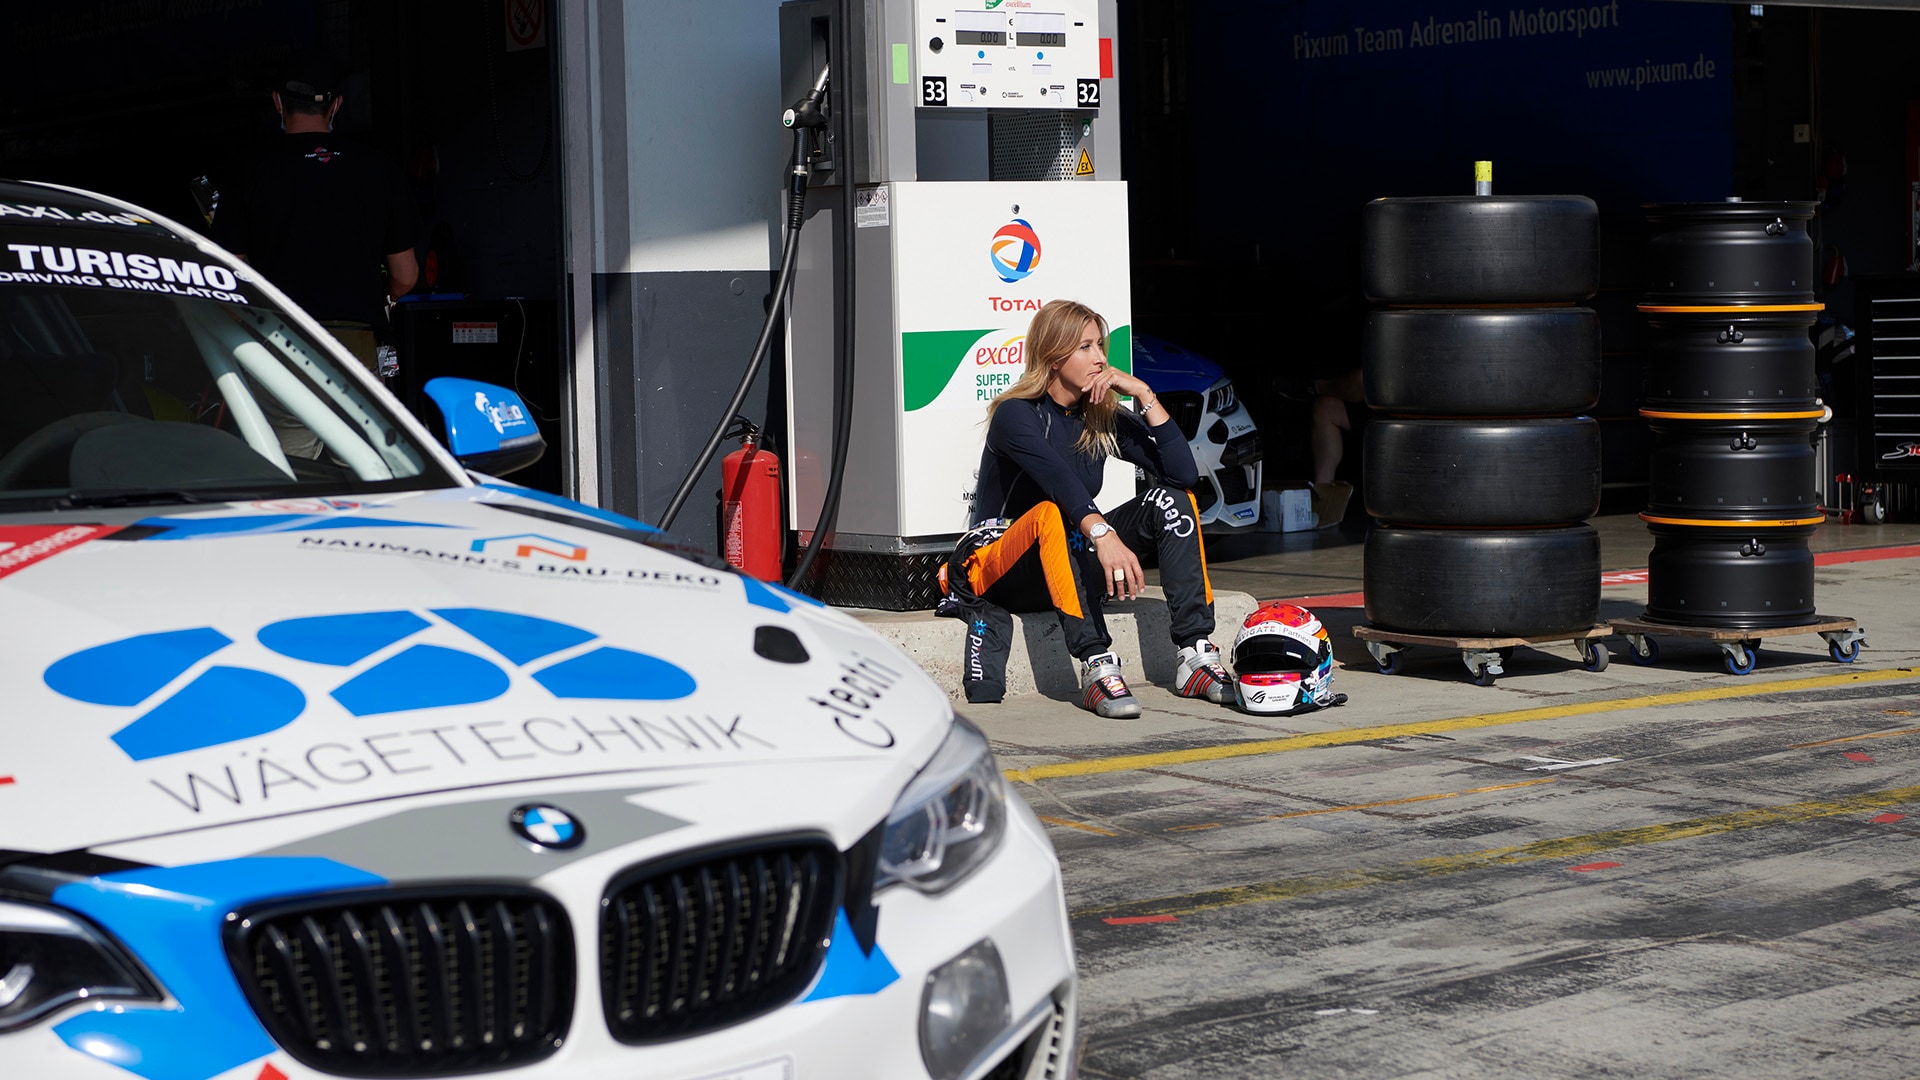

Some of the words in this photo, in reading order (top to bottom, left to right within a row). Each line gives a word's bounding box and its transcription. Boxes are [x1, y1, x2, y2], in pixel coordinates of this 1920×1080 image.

[1293, 31, 1350, 60] Pixum
[1354, 26, 1404, 53] Team
[1409, 10, 1502, 48] Adrenalin
[1508, 0, 1619, 39] Motorsport
[1586, 52, 1716, 92] www.pixum.de
[925, 80, 946, 102] 33
[1078, 83, 1099, 104] 32
[1081, 161, 1090, 172] EX
[7, 243, 238, 292] TURISMO
[0, 271, 103, 287] DRIVING
[105, 277, 249, 305] SIMULATOR
[975, 373, 1010, 387] SUPER
[302, 537, 520, 569] NAUMANN'S
[537, 562, 721, 586] BAU-DEKO
[1282, 627, 1312, 646] Partners
[969, 634, 983, 682] pixum
[149, 713, 778, 814] WÄGETECHNIK
